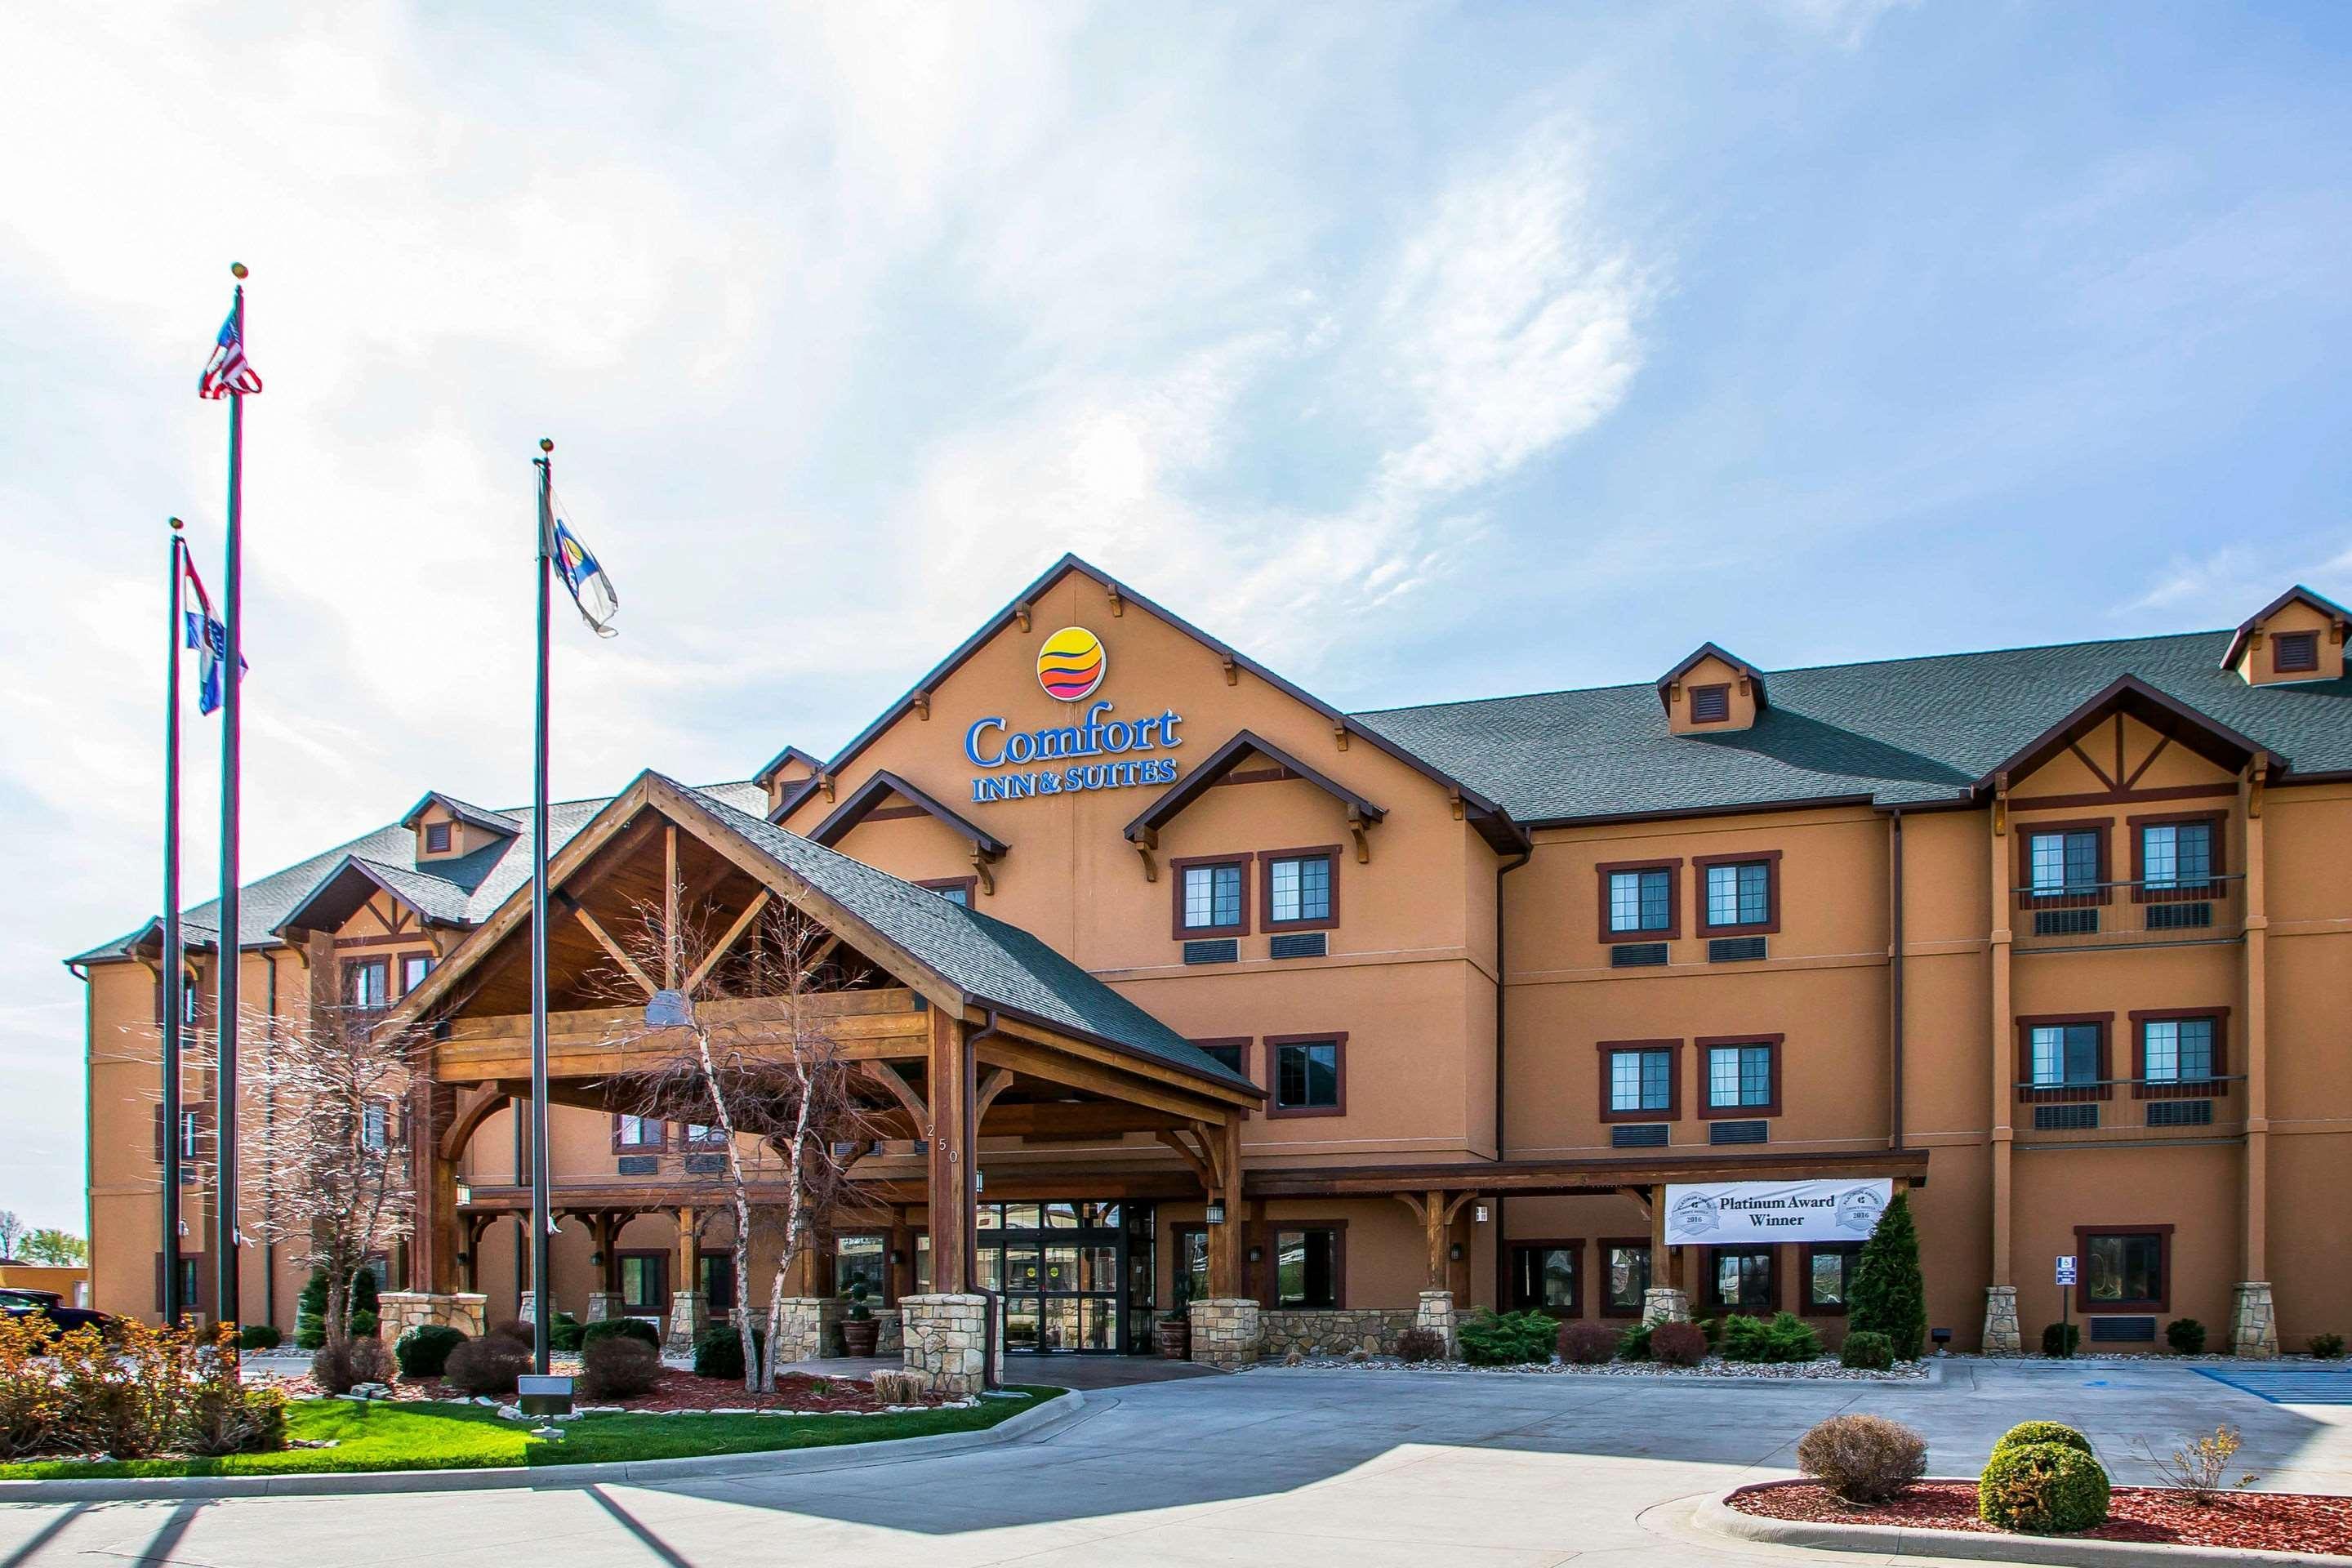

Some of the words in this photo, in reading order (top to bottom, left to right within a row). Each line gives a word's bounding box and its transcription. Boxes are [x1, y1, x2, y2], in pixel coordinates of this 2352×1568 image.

[964, 701, 1183, 768] Comfort
[1065, 758, 1177, 792] SUITES
[1719, 1196, 1785, 1209] Platinum
[1788, 1195, 1835, 1208] Award
[1748, 1214, 1805, 1227] Winner
